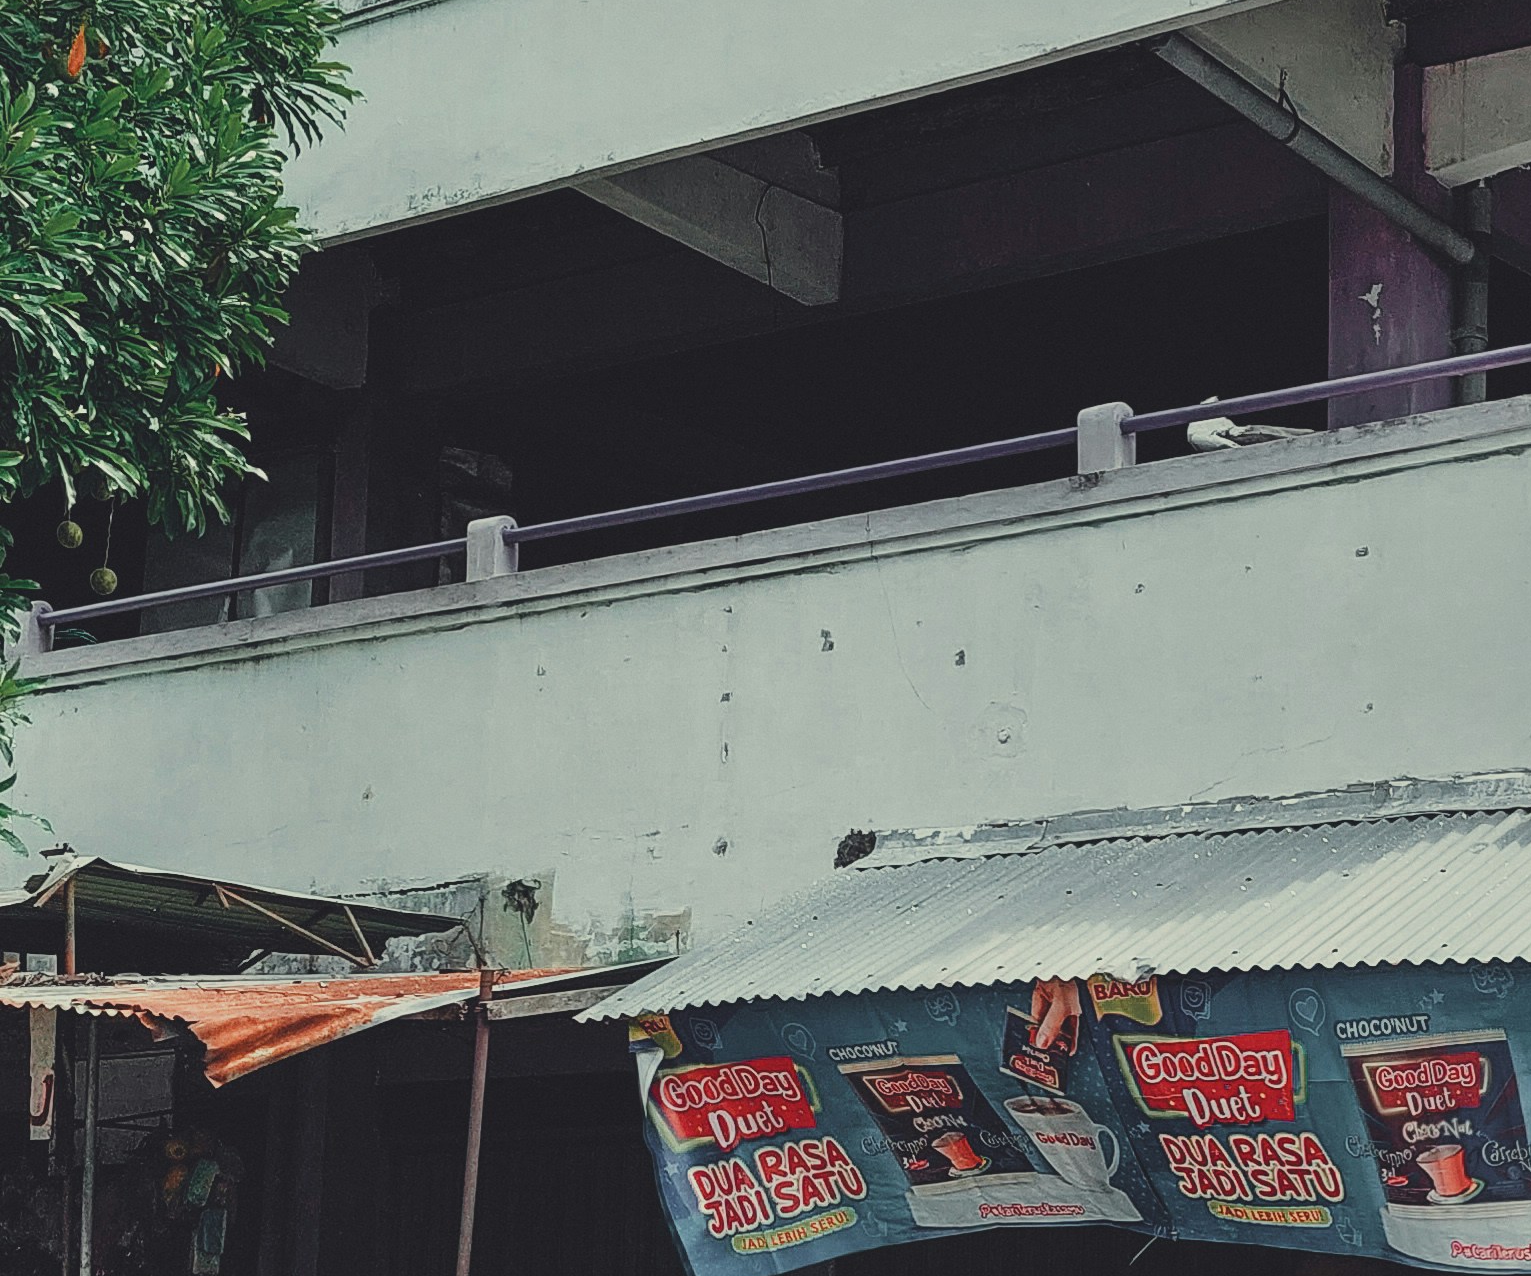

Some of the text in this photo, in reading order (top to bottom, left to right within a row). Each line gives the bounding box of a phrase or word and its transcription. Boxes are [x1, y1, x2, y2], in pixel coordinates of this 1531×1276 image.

[1335, 1015, 1430, 1040] CHOCO'NUT
[1183, 1085, 1261, 1125] Duet
[1405, 1087, 1456, 1116] Duet
[707, 1100, 784, 1148] Duet
[690, 1138, 851, 1201] DUA RASA
[1161, 1135, 1330, 1169] DUA RASA
[1173, 1165, 1343, 1199] JADI SATU
[703, 1166, 866, 1235] JADI SATU
[1218, 1204, 1248, 1220] JADI
[771, 1228, 808, 1247] LEBIH
[810, 1210, 851, 1234] SERU!
